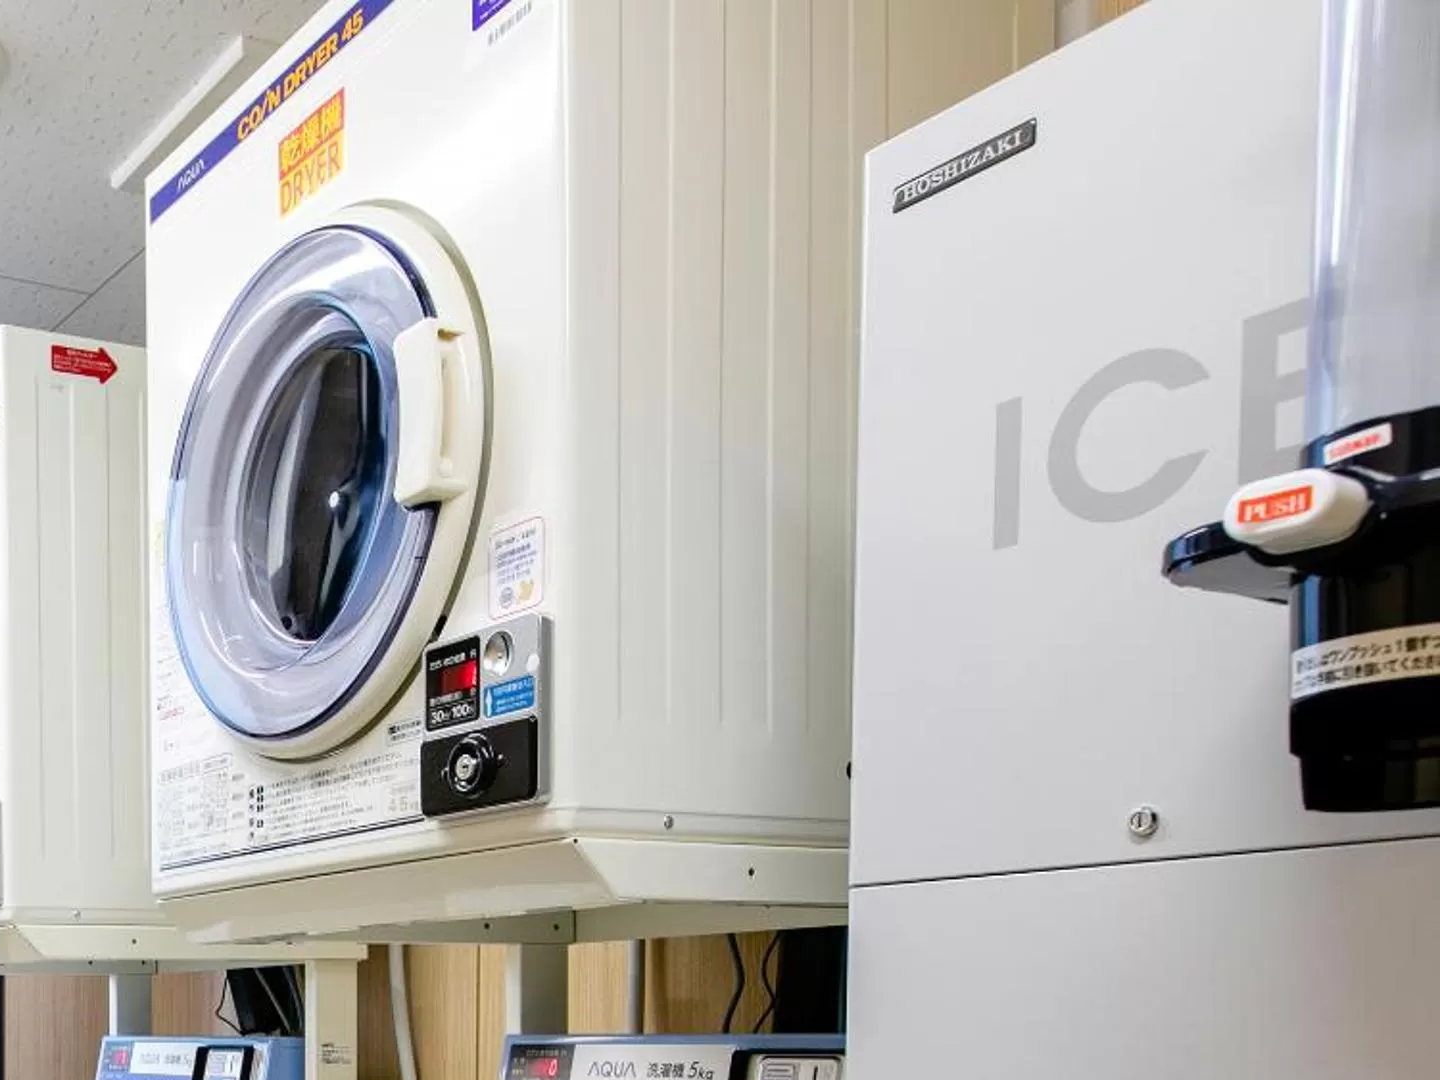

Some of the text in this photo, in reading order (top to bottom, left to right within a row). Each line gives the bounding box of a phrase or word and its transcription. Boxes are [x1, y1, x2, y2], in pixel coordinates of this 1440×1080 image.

[284, 33, 339, 100] DRYER
[342, 9, 364, 41] 45
[282, 141, 340, 212] DRYER
[902, 130, 1023, 201] HOSHIZAKI
[993, 292, 1332, 550] ICE
[1244, 492, 1306, 522] PUSH
[587, 1061, 637, 1079] AQUA
[647, 1062, 685, 1079] 洗濯機
